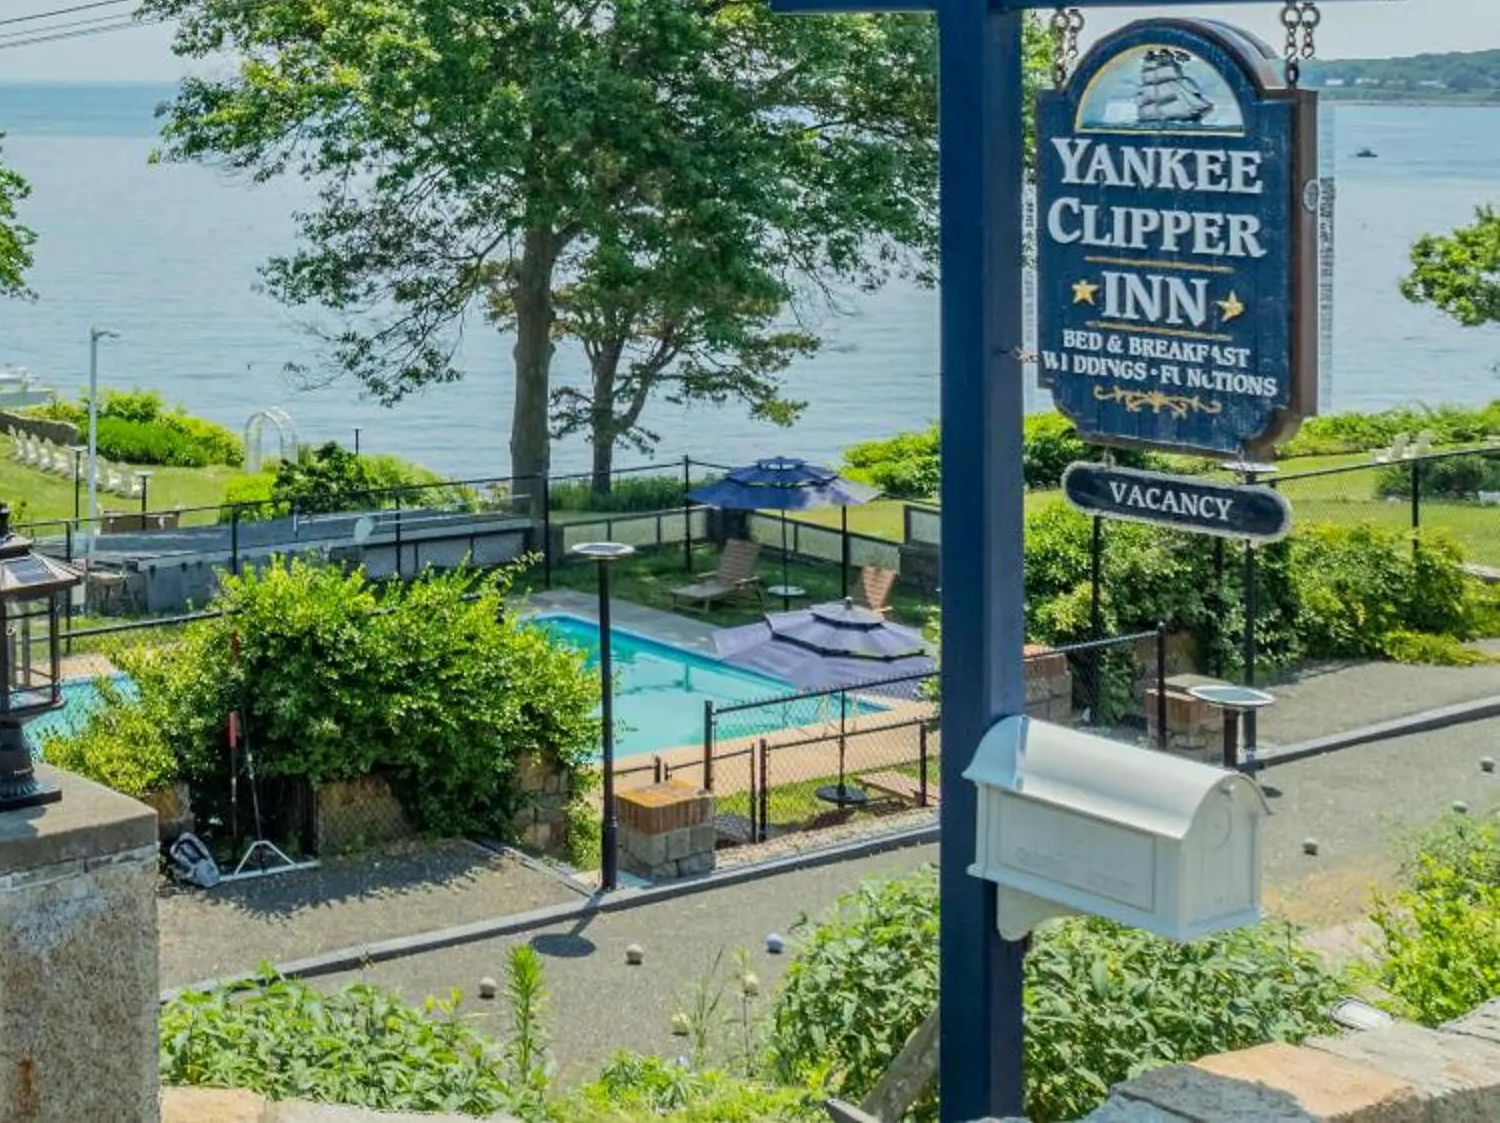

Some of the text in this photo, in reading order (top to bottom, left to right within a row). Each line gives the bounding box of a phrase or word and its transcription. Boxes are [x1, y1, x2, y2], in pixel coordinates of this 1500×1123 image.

[1051, 138, 1263, 194] YANKEE
[1047, 197, 1267, 258] CLIPPER
[1101, 270, 1210, 326] INN
[1062, 329, 1251, 368] BED & BREAKFAST
[1109, 481, 1234, 521] VACANCY
